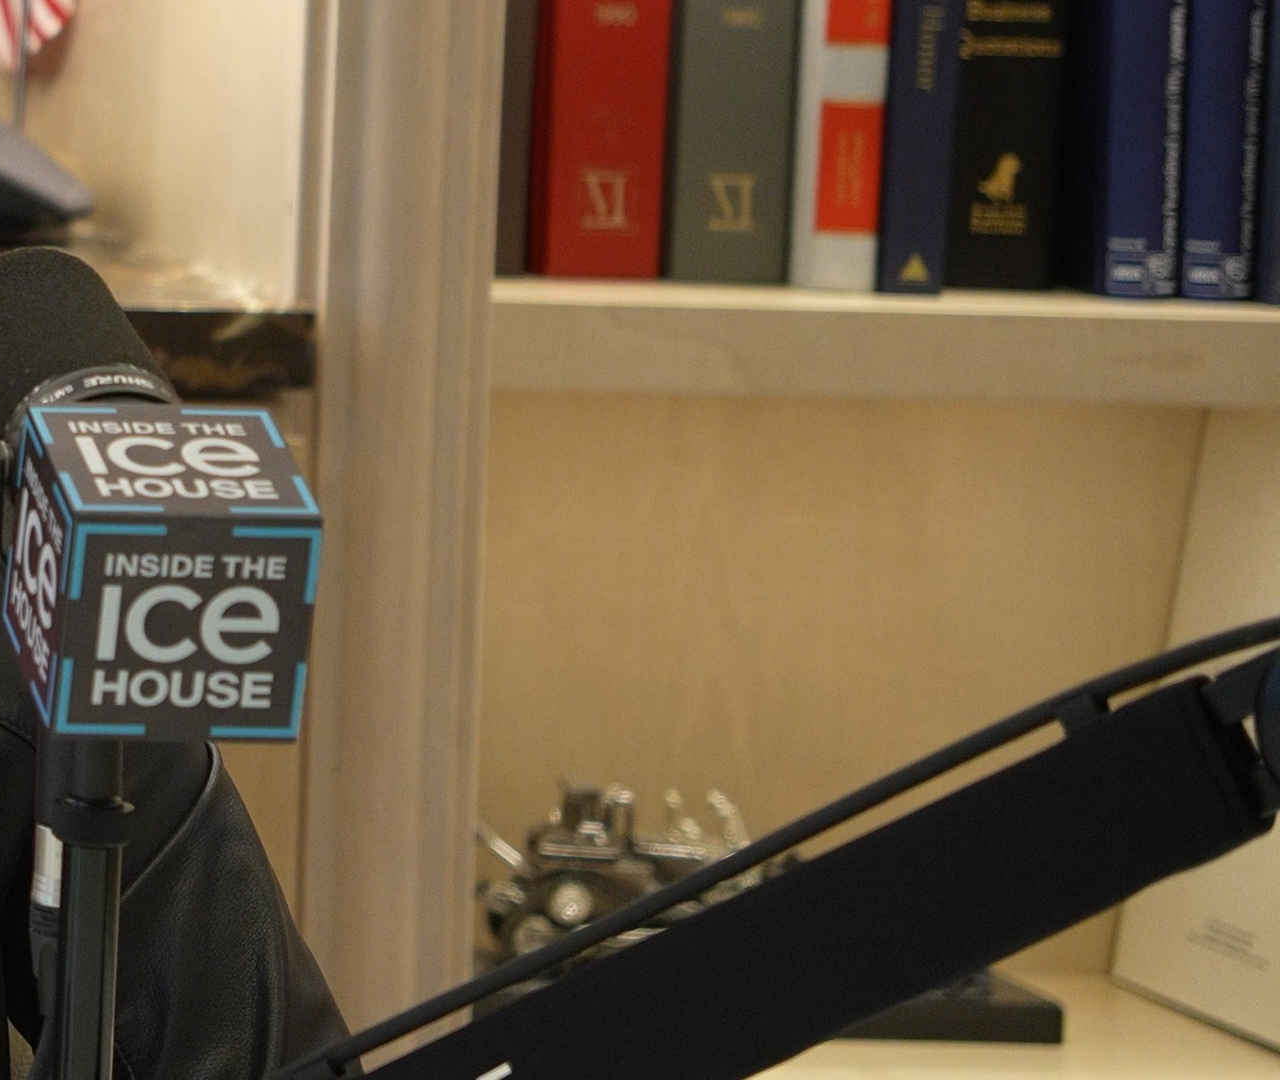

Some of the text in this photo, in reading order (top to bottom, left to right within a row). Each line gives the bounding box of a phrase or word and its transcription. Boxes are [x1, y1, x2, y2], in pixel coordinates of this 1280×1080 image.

[83, 375, 156, 390] SHURE
[67, 421, 248, 437] INSIDE THE
[92, 476, 281, 501] HOUSE
[104, 552, 288, 580] INSIDE THE
[11, 570, 51, 684] HOUSE
[91, 669, 275, 710] HOUSE
